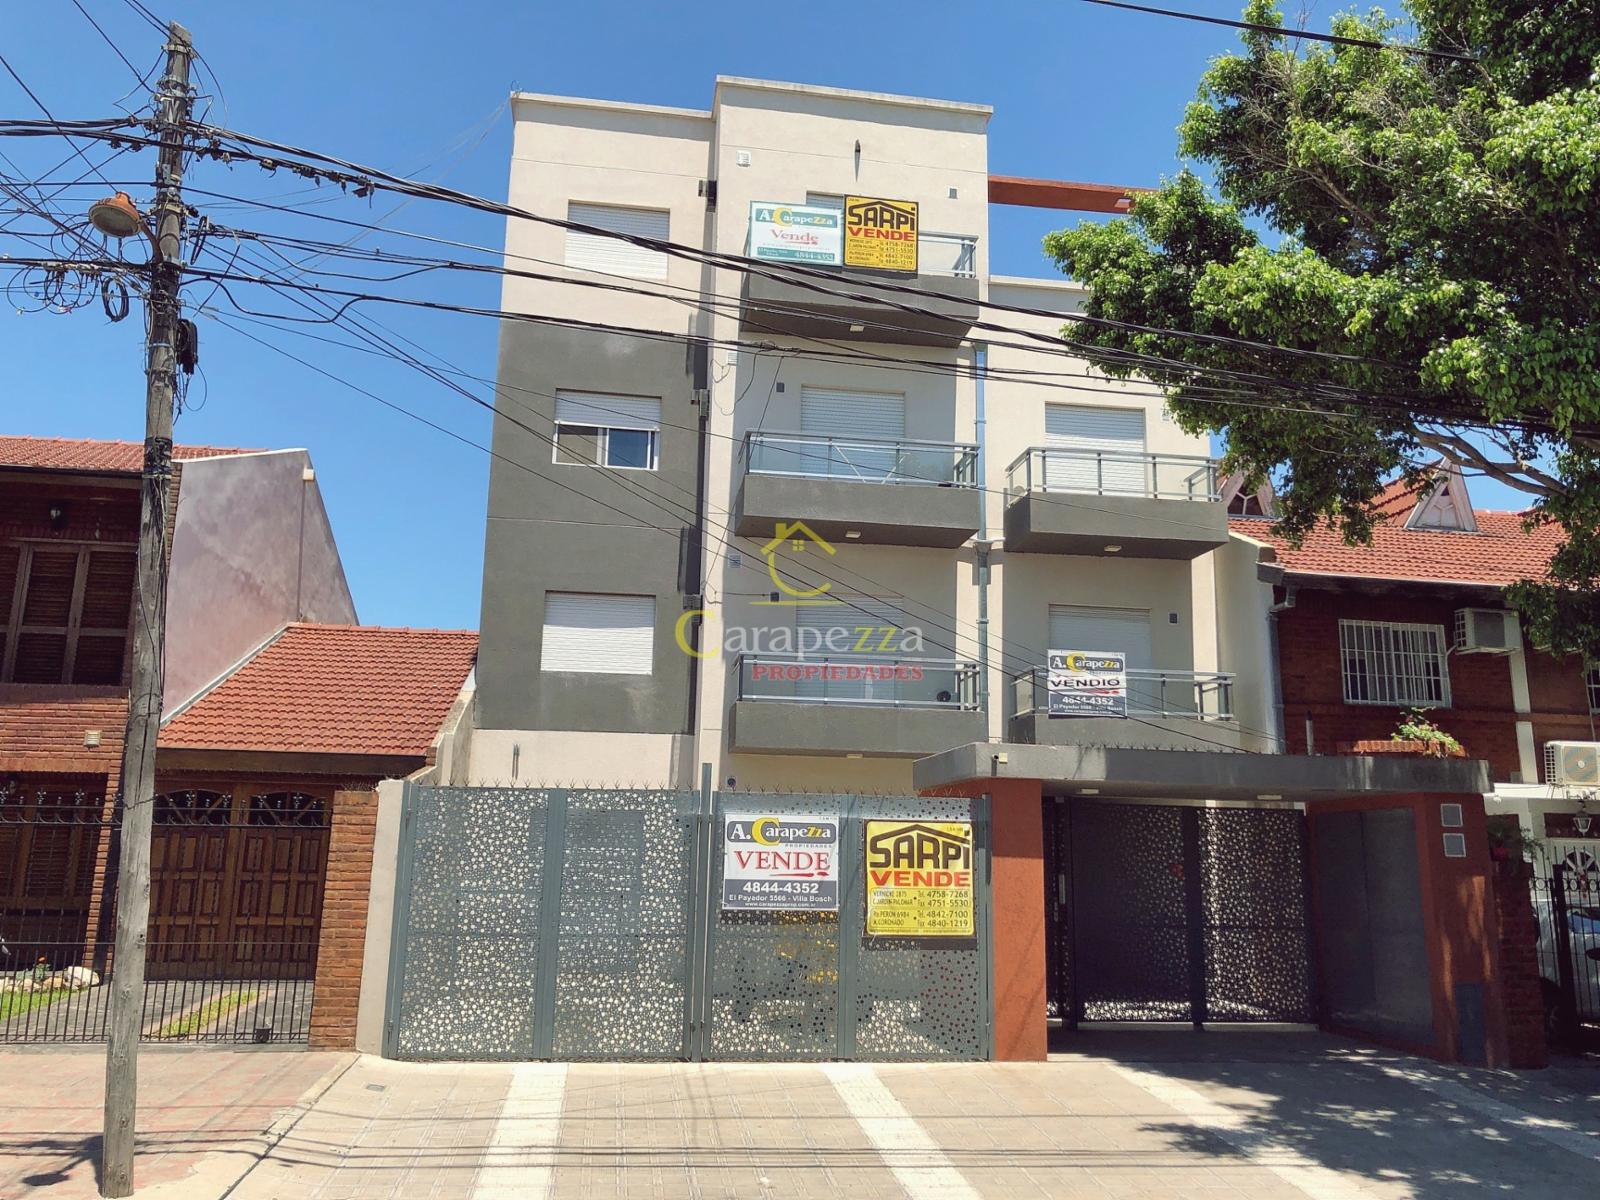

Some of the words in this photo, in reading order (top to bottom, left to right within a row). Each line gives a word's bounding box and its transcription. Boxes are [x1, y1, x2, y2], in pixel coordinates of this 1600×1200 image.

[771, 229, 820, 243] Vende
[847, 227, 915, 242] VENDE
[1050, 679, 1120, 688] VENDIO
[730, 823, 751, 840] A.
[751, 817, 831, 846] Carapezza
[733, 850, 831, 871] VENDE
[869, 870, 971, 888] VENDE
[743, 881, 819, 894] 4844-4352
[738, 894, 768, 903] Payador
[809, 895, 832, 903] Bosch
[927, 890, 969, 898] 4758-7268
[927, 899, 969, 907] 4751-5530
[926, 910, 969, 918] 4842-7100
[927, 919, 969, 927] 4840-1219
